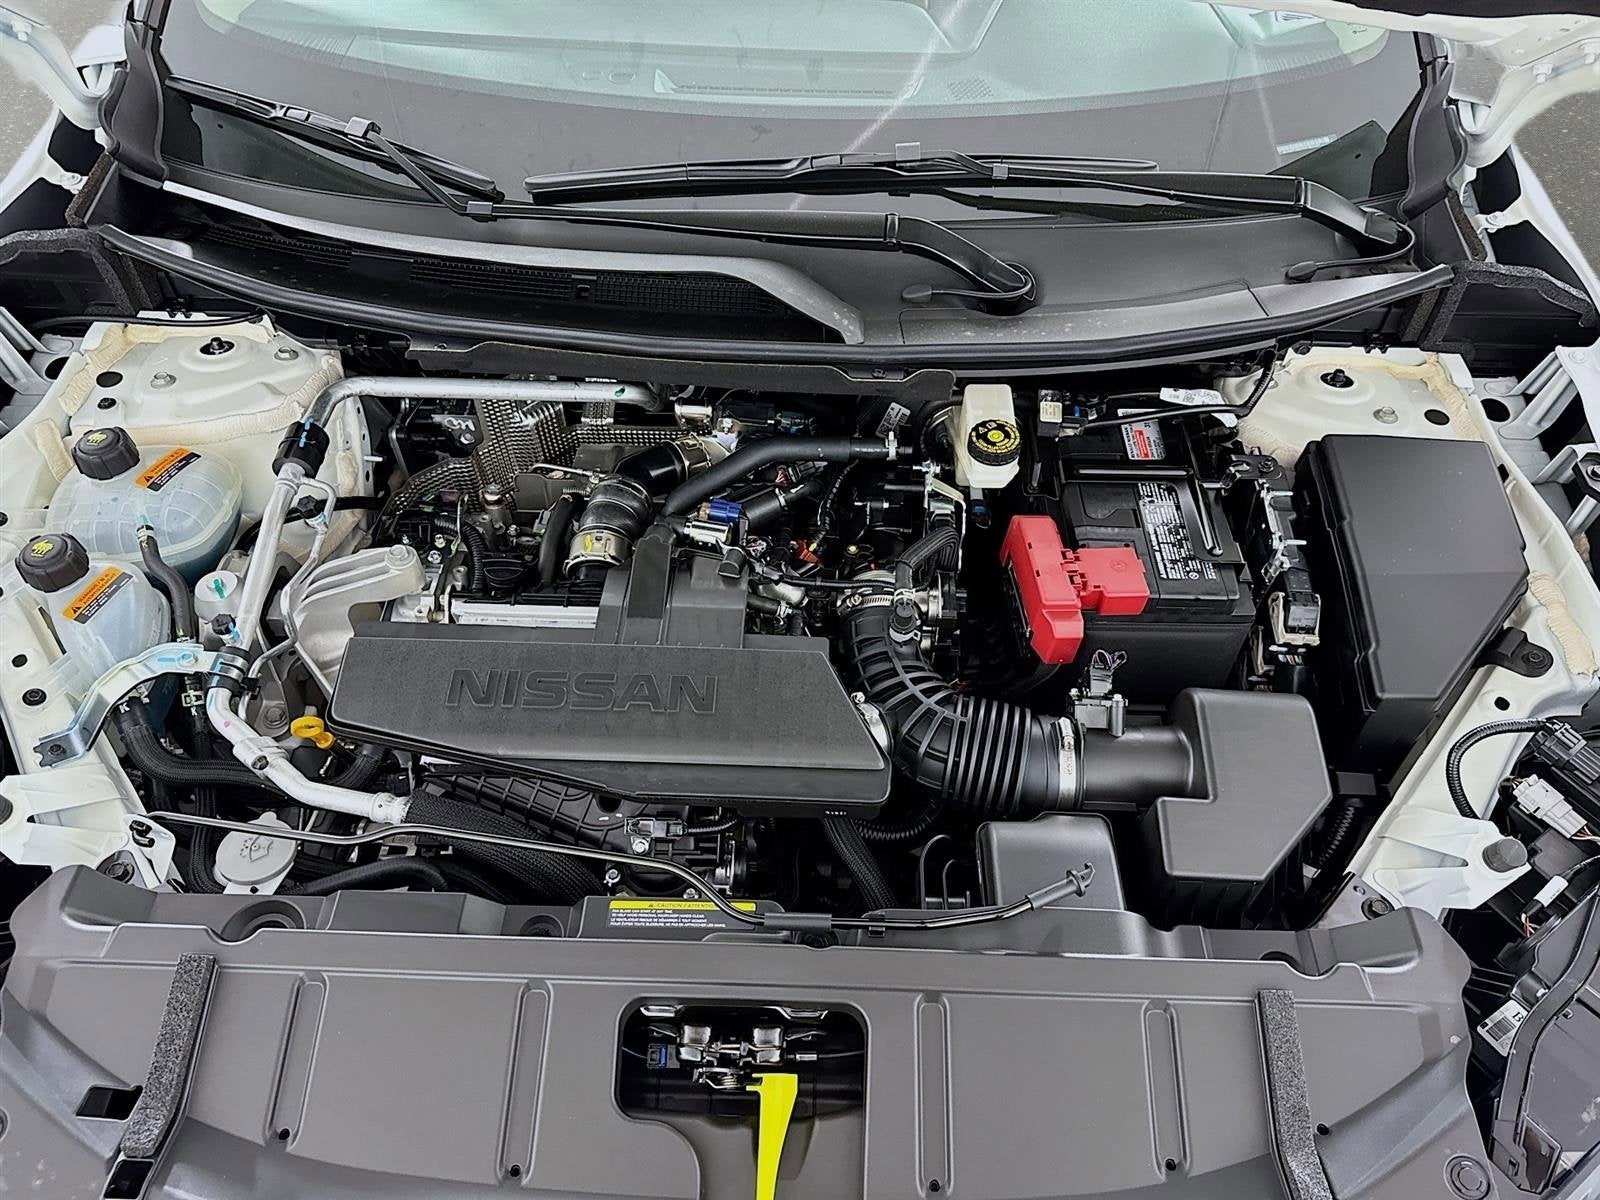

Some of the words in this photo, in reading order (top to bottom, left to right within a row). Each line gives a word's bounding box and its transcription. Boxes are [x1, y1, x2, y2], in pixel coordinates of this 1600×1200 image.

[445, 668, 718, 714] NISSAN
[118, 702, 130, 714] K
[1511, 1010, 1525, 1023] B
